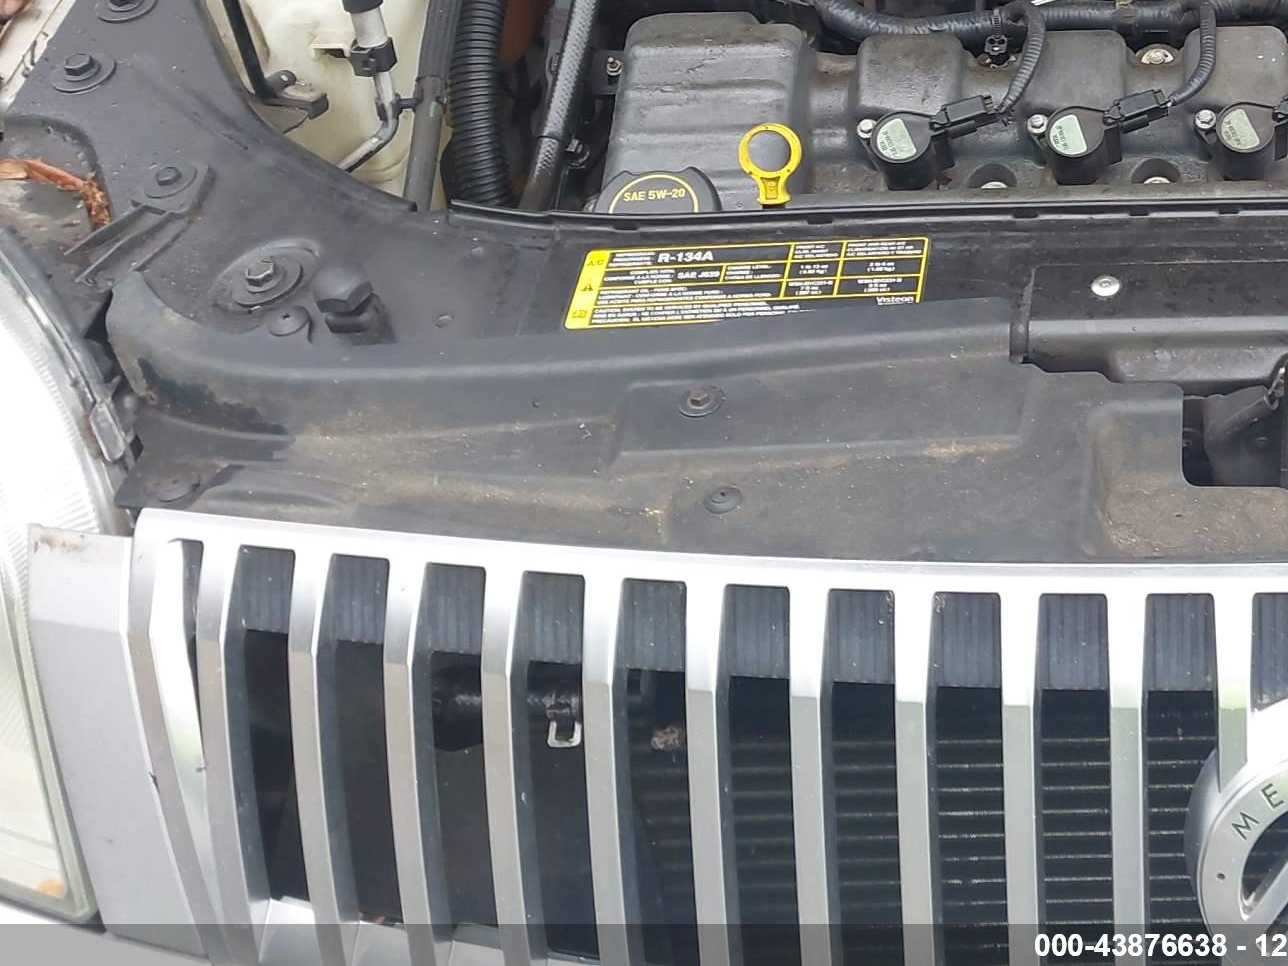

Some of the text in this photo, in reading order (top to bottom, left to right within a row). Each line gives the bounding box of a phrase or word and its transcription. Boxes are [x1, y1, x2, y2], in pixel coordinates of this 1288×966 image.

[623, 188, 686, 202] SAE 5W-20
[657, 250, 714, 263] R-134A
[677, 272, 698, 280] SAE
[876, 296, 914, 306] Visteon
